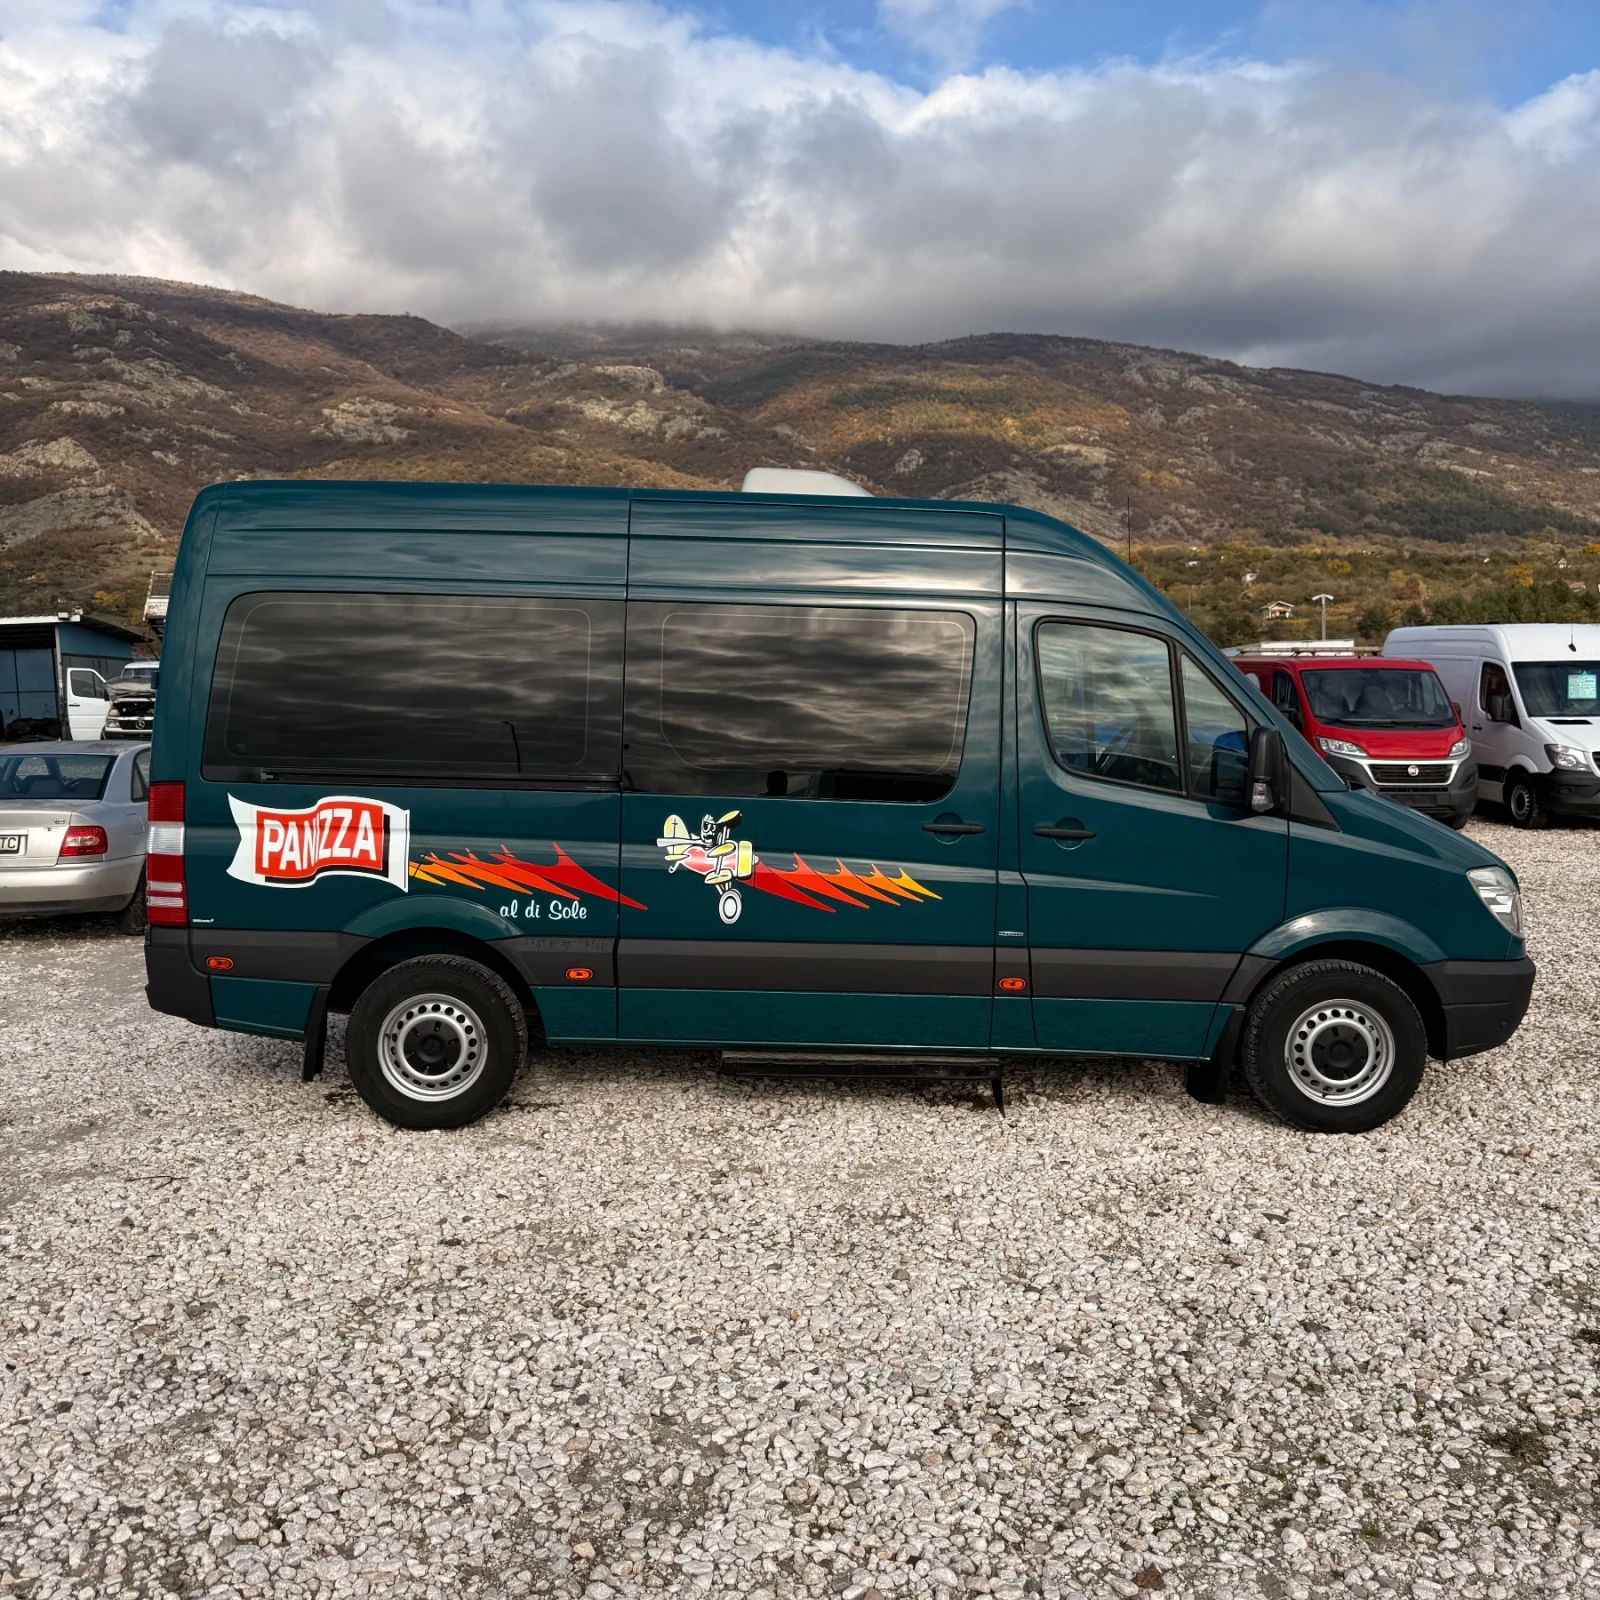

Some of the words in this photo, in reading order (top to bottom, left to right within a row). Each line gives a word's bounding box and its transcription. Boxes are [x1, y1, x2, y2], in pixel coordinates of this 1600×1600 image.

[261, 808, 377, 871] PANIZZA
[500, 899, 518, 918] al
[525, 899, 540, 918] di
[548, 900, 587, 920] Sole
